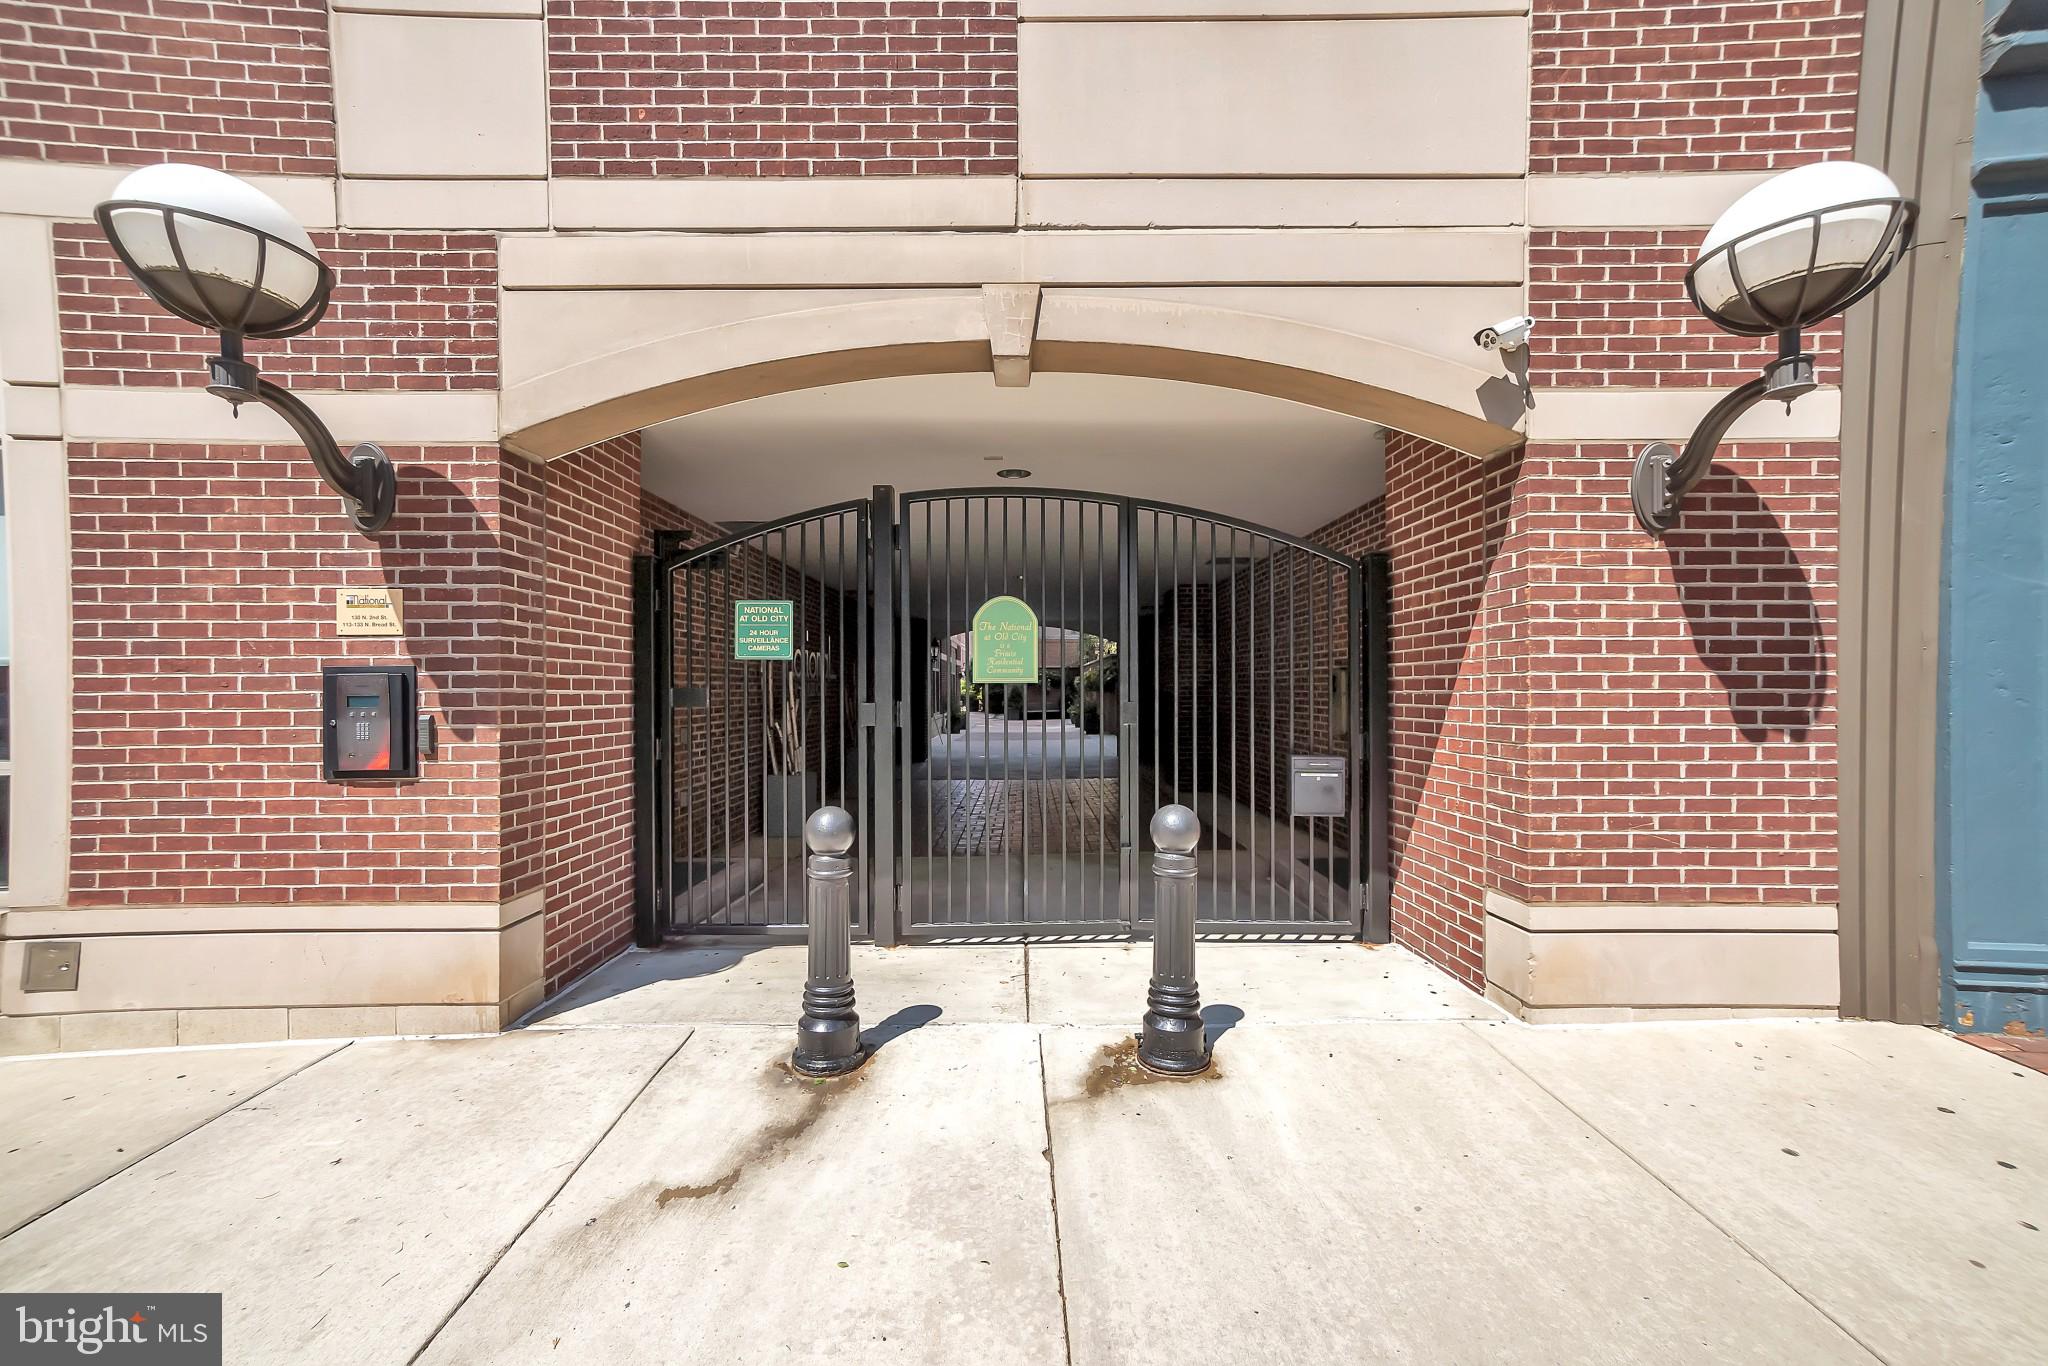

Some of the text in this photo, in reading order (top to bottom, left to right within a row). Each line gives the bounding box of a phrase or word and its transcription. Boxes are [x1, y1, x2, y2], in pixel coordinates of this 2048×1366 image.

[744, 606, 784, 614] NATIONAL
[979, 621, 1032, 631] The National
[994, 632, 1009, 641] Old
[1011, 632, 1027, 643] City
